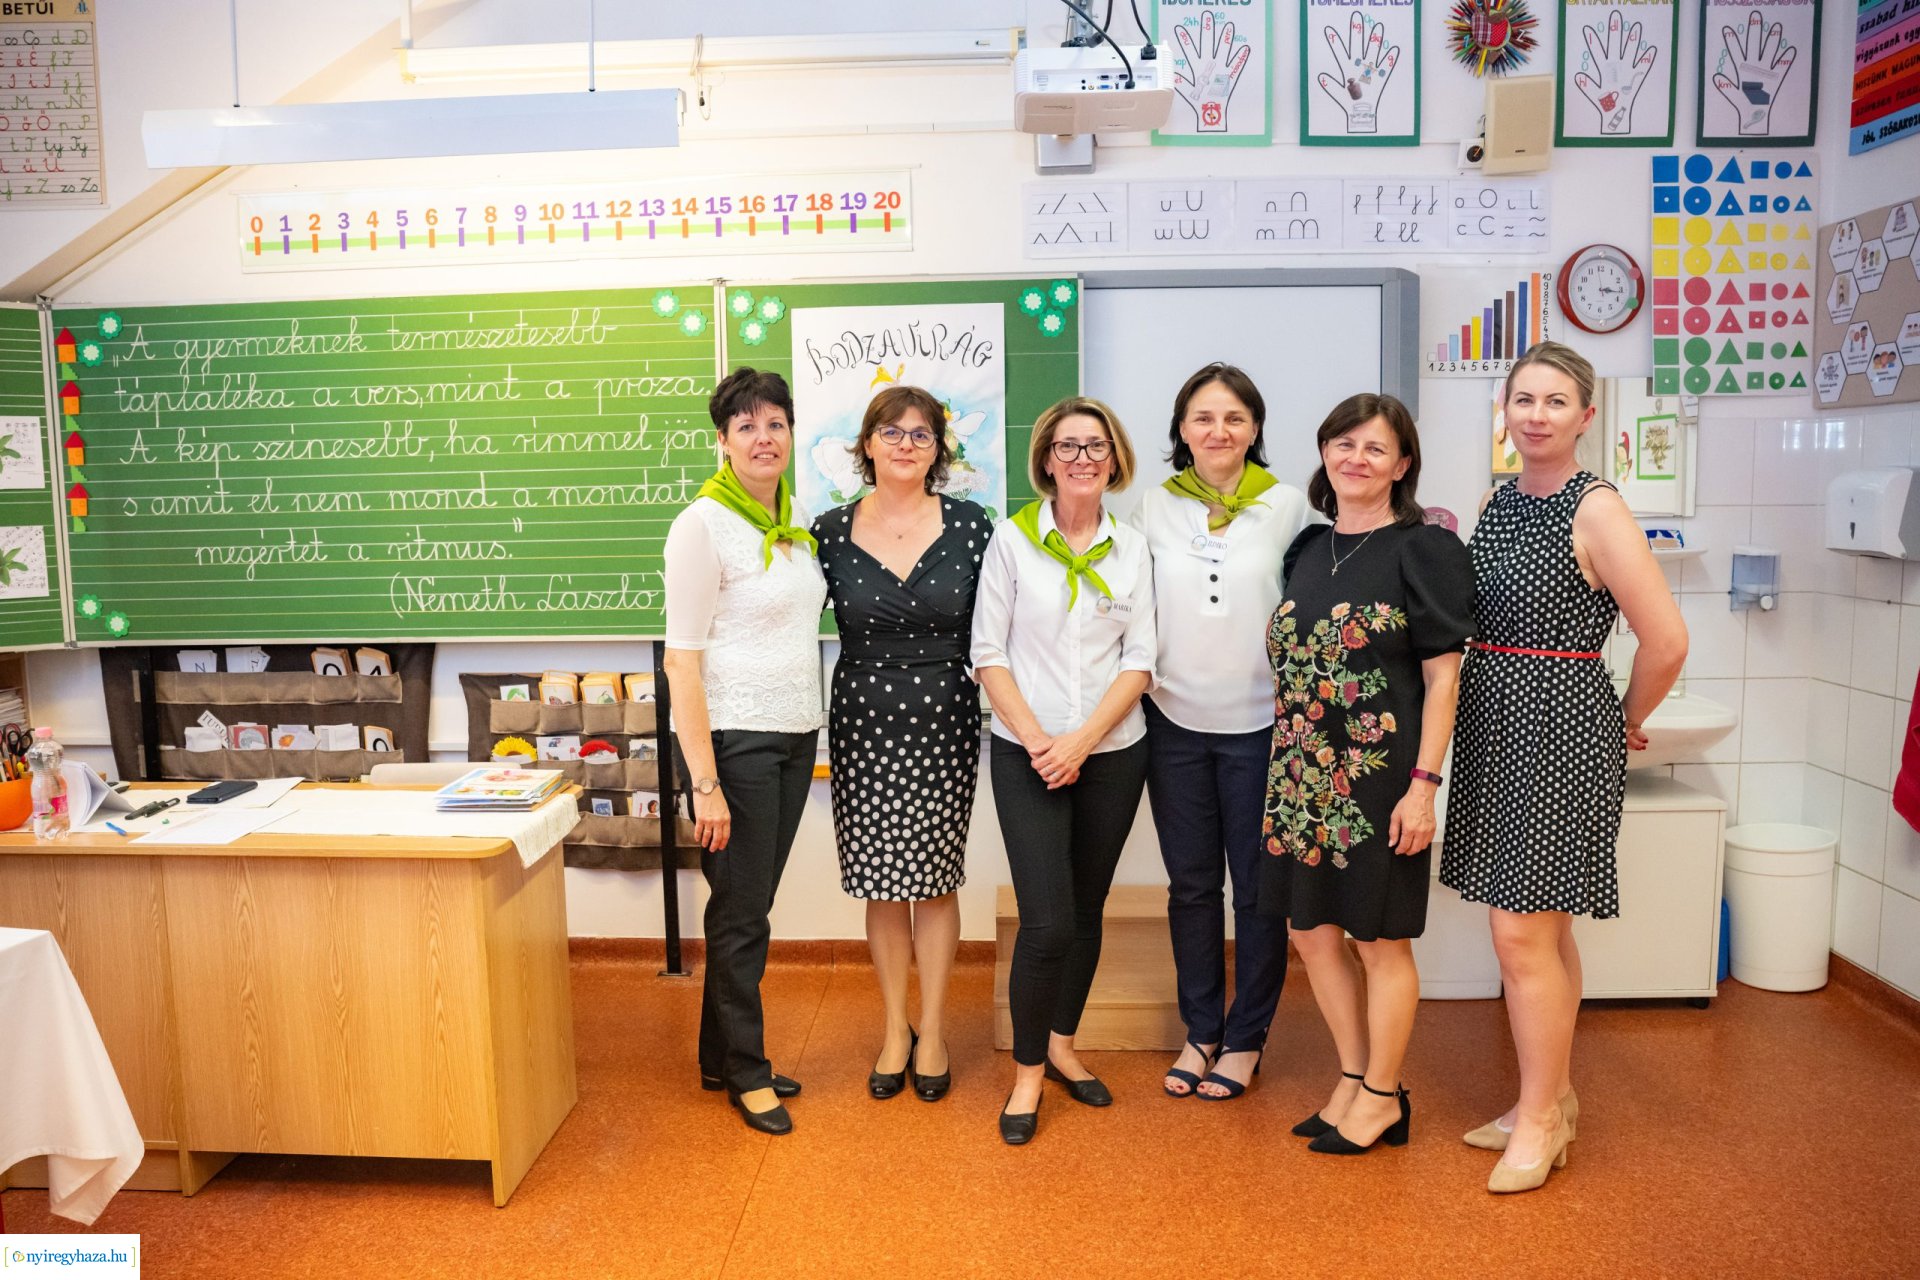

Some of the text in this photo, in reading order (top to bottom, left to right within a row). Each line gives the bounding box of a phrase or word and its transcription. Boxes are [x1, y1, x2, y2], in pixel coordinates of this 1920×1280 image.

[250, 191, 901, 233] 0 1 2 3 4 5 6 7 8 9 10 11 12 13 14 15 16 17 18 19 20
[173, 315, 368, 375] gyermeknek
[386, 307, 618, 351] természetesebb
[1428, 361, 1511, 372] 1 2 3 4 5 6 7 8
[114, 372, 295, 428] tápláléka
[312, 387, 340, 407] a
[545, 380, 571, 399] a
[593, 359, 713, 416] próza.
[119, 428, 158, 465] A
[174, 426, 240, 479] kép
[444, 417, 499, 455] ha
[512, 414, 653, 453] rímmel
[122, 466, 696, 517] s amit el nem mond a mondat
[194, 527, 329, 582] megértet
[348, 543, 371, 562] a
[390, 570, 526, 620] (Németh
